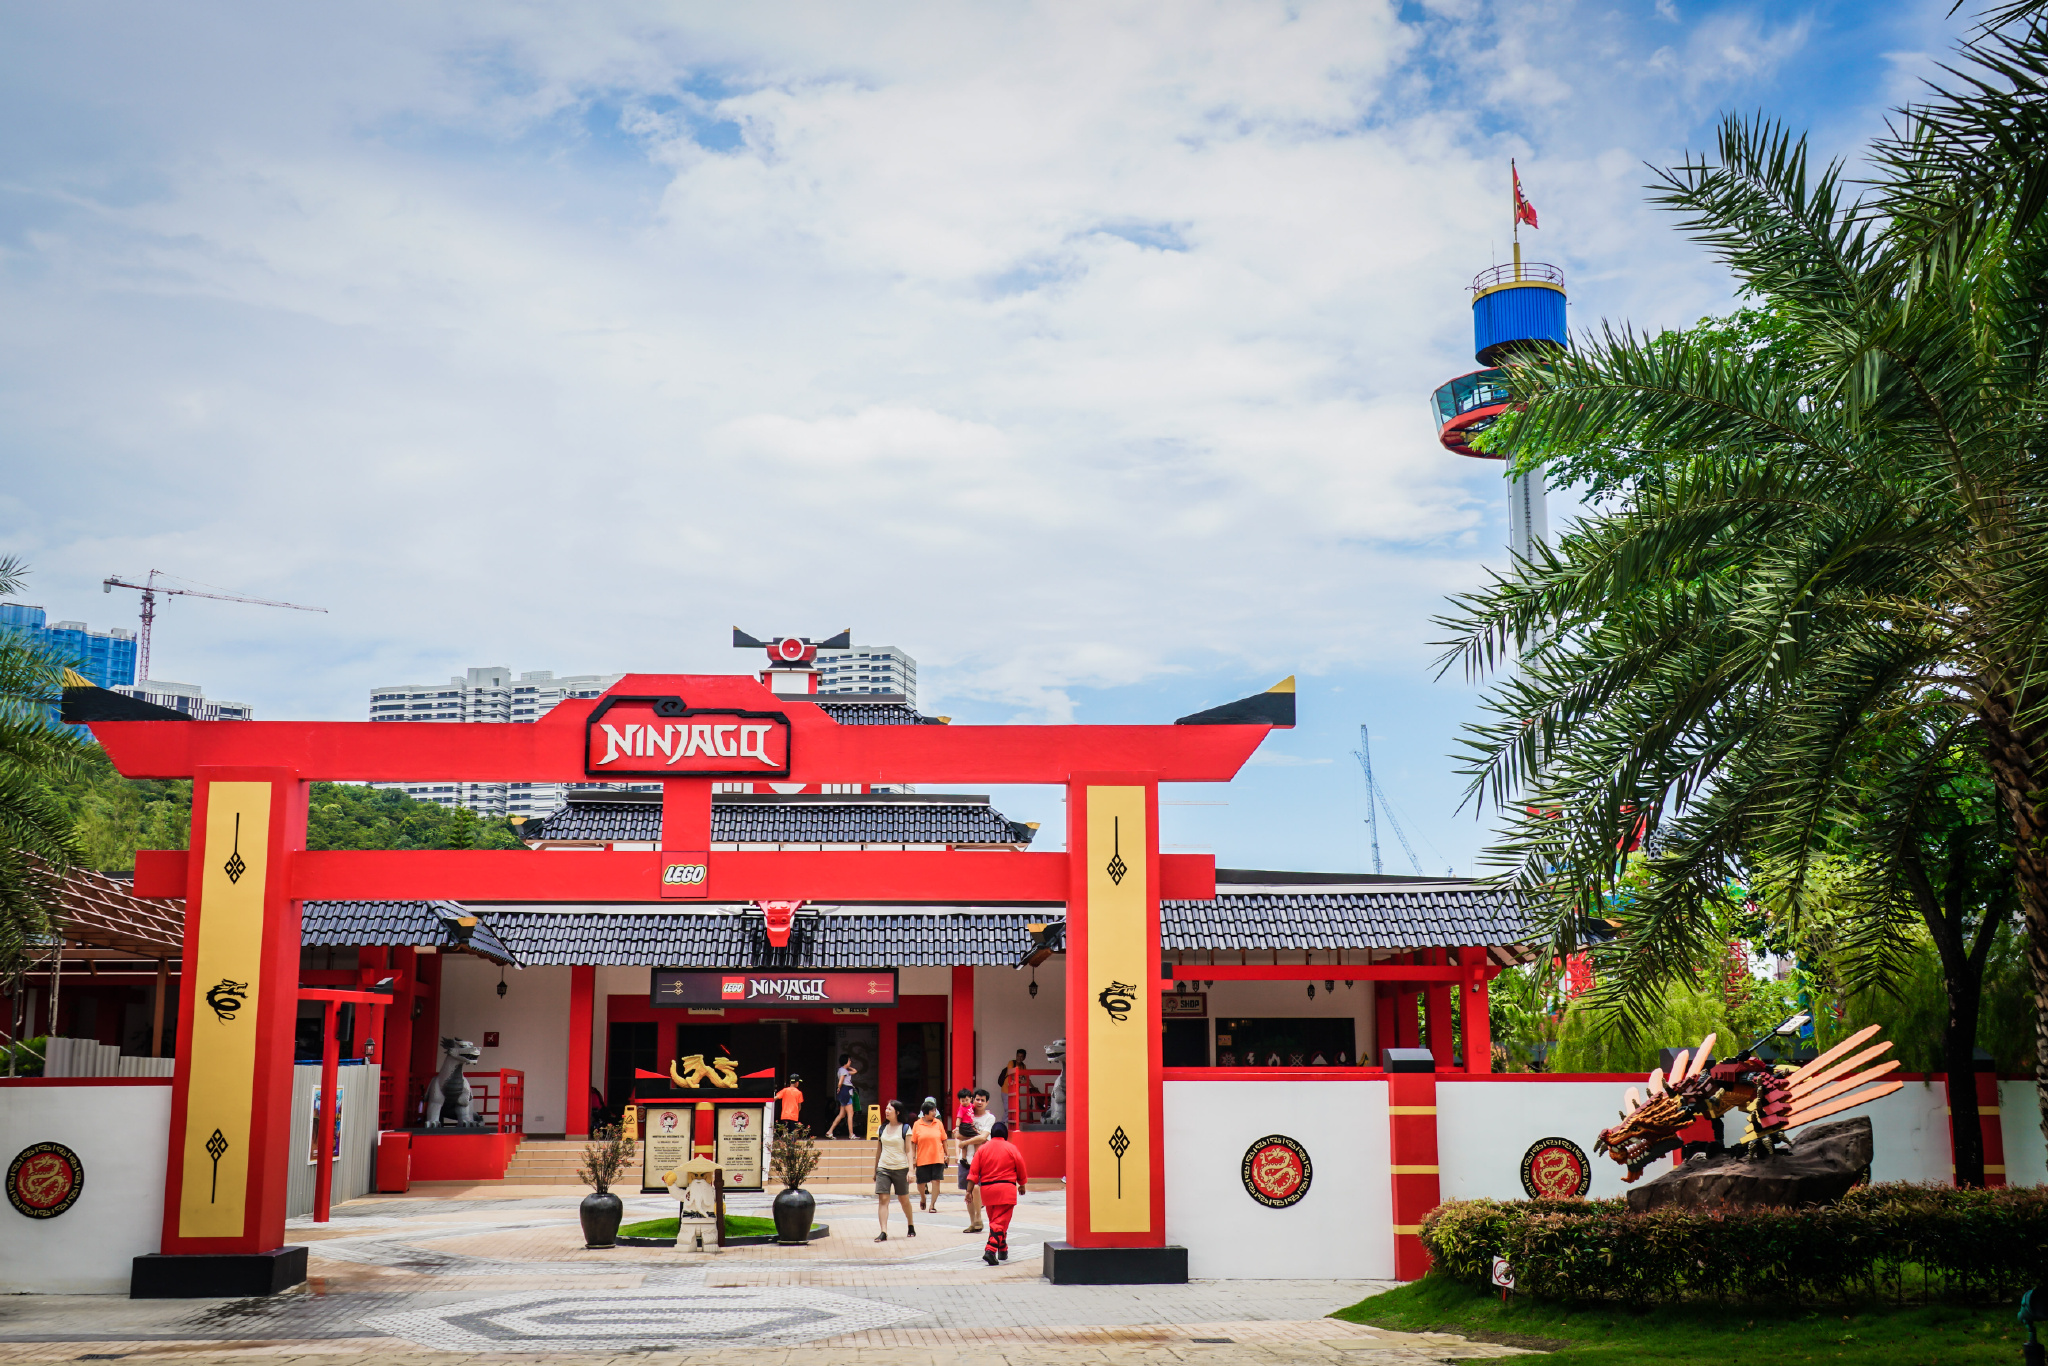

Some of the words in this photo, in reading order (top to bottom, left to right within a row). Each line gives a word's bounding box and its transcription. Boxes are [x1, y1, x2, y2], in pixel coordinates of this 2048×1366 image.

[596, 724, 780, 767] NINJAGO
[664, 865, 706, 884] LEGO
[723, 983, 744, 993] LEGO
[747, 980, 830, 999] NINJAGO
[1180, 1000, 1199, 1008] SHOP
